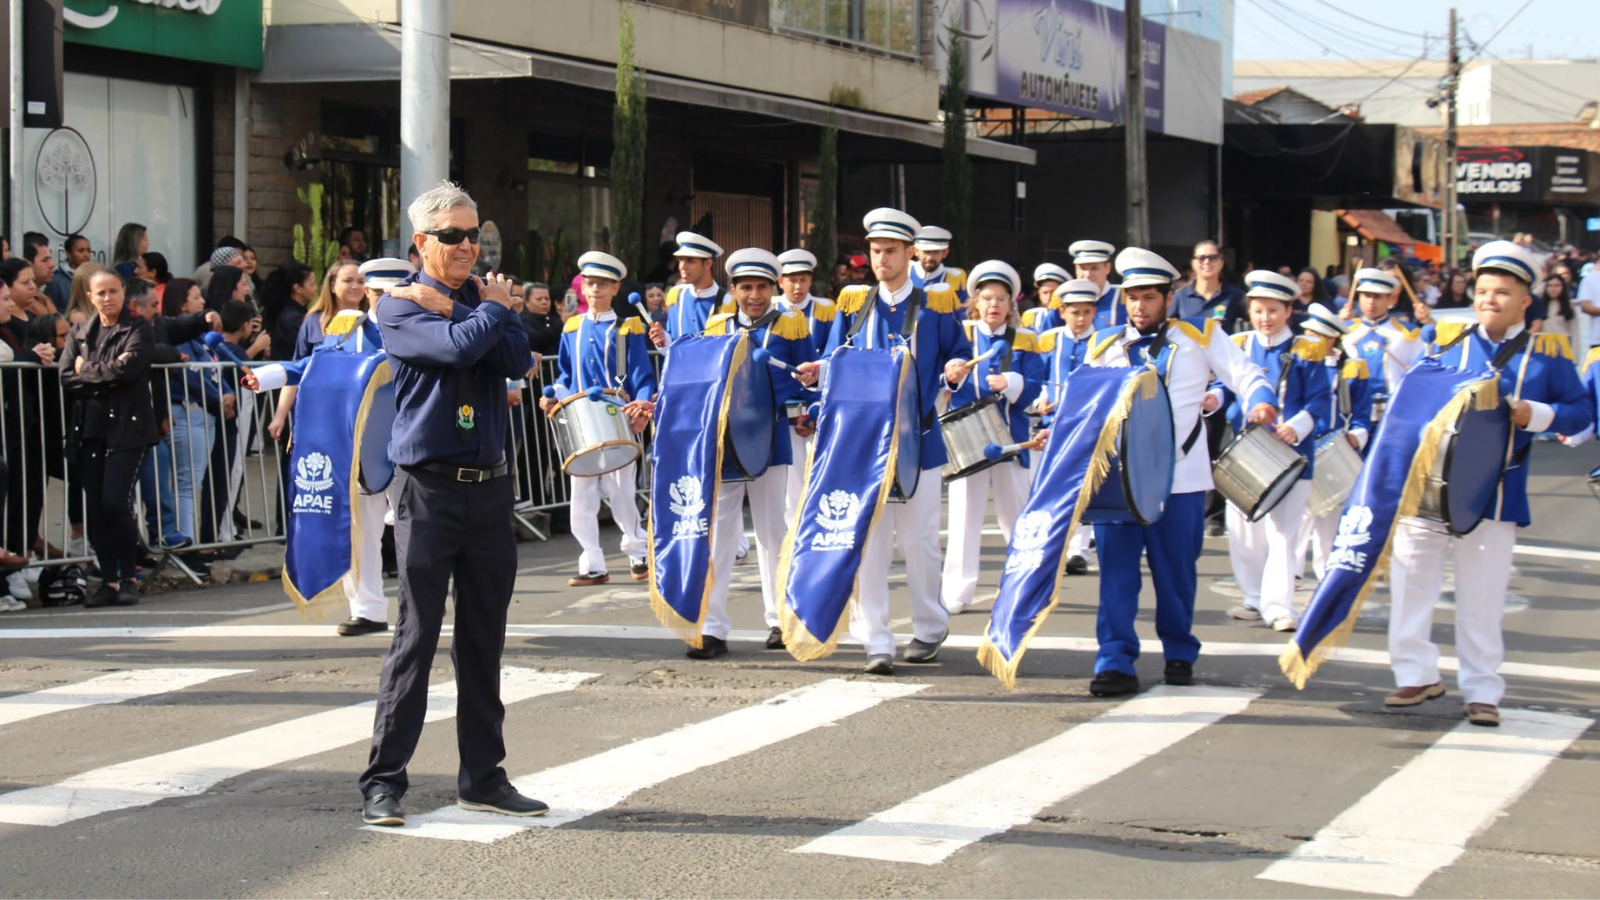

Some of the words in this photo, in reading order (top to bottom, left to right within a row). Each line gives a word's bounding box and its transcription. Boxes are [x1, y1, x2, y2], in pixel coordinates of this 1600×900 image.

[1020, 71, 1099, 111] AUTOMÓVEIS
[1457, 179, 1521, 193] EÍCULOS
[293, 494, 333, 509] APAE
[672, 518, 708, 535] APAE
[812, 531, 855, 546] APAE
[1005, 549, 1044, 570] AE
